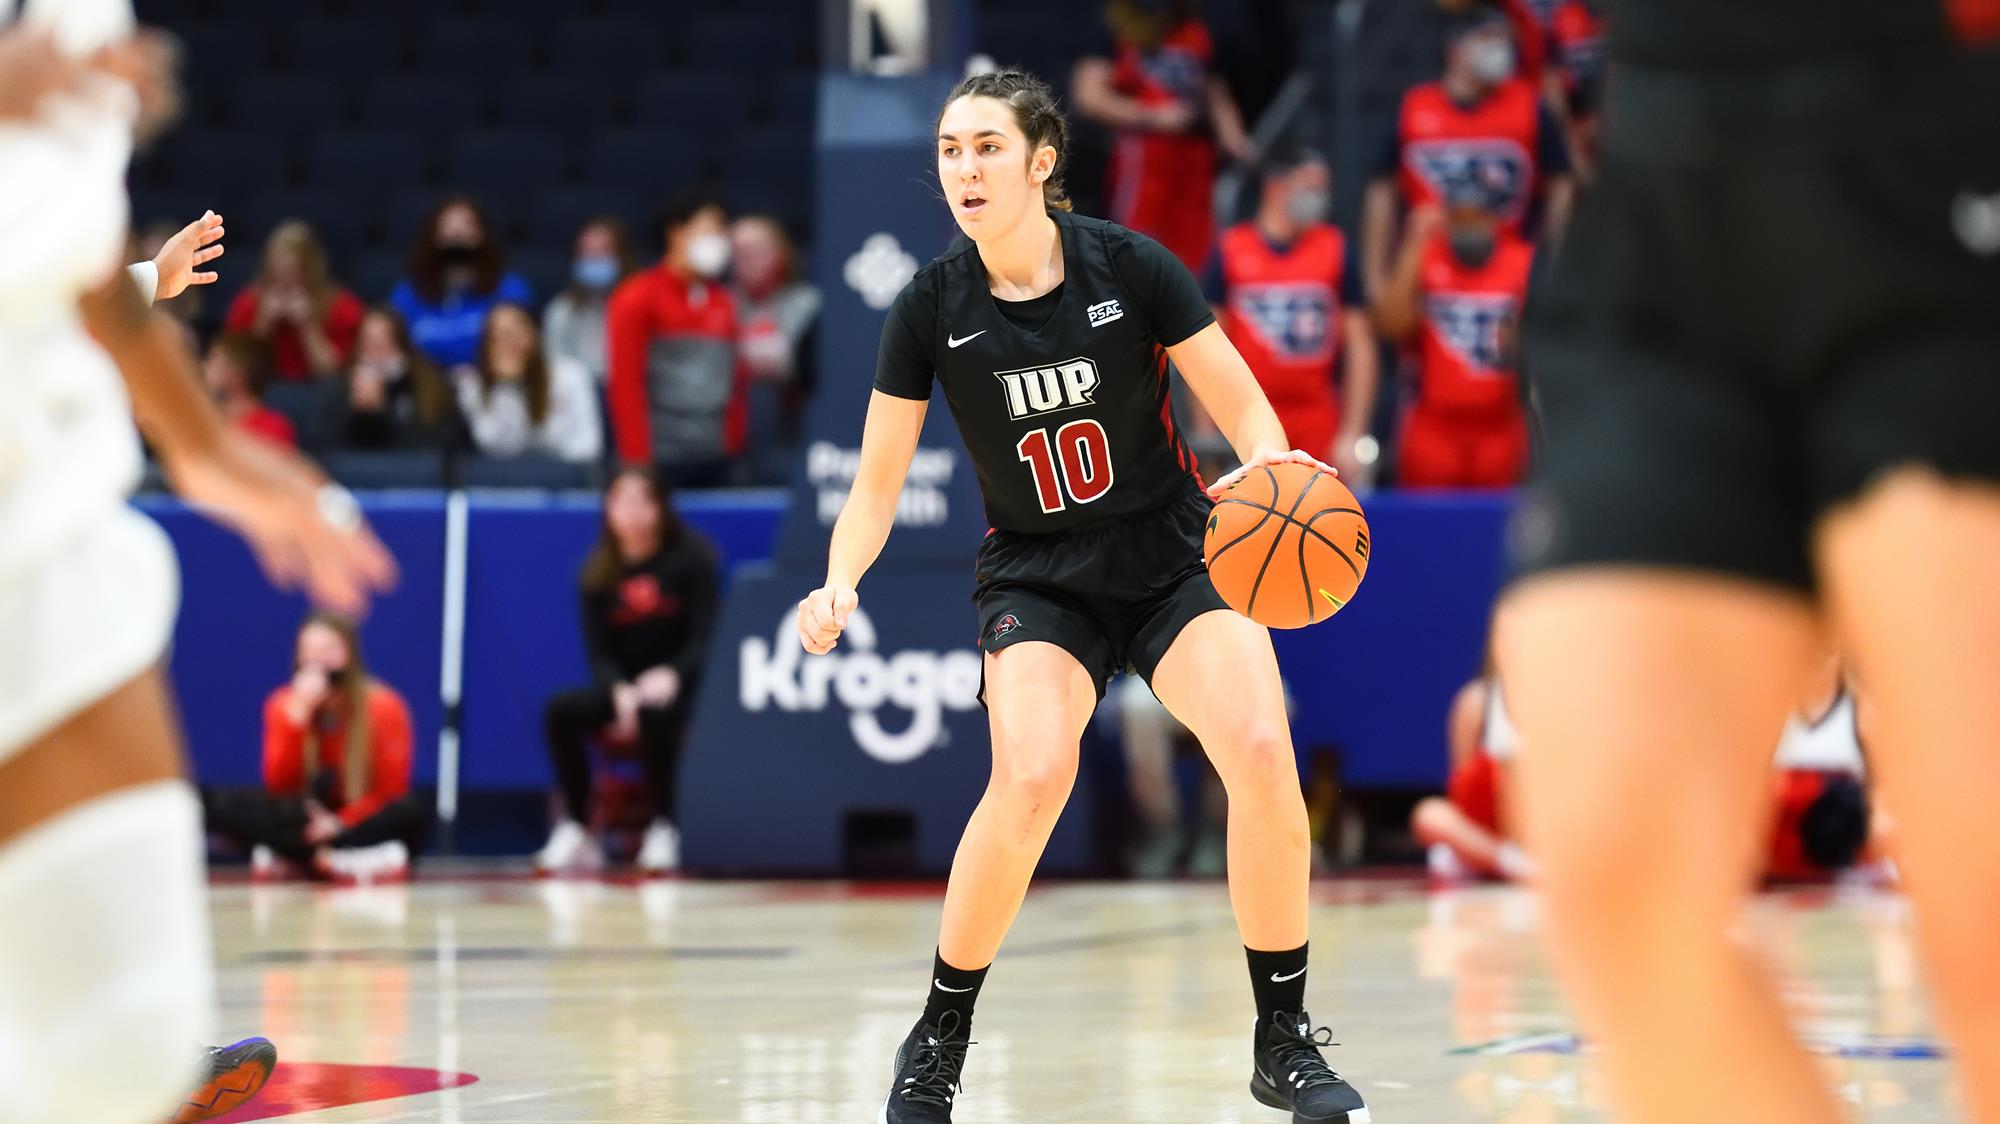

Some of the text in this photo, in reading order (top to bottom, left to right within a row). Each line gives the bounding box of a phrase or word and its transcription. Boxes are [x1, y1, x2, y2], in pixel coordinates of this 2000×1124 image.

[1087, 302, 1123, 323] PSAC
[999, 358, 1098, 418] IUP
[1016, 418, 1114, 514] 10
[738, 601, 983, 763] Kroge
